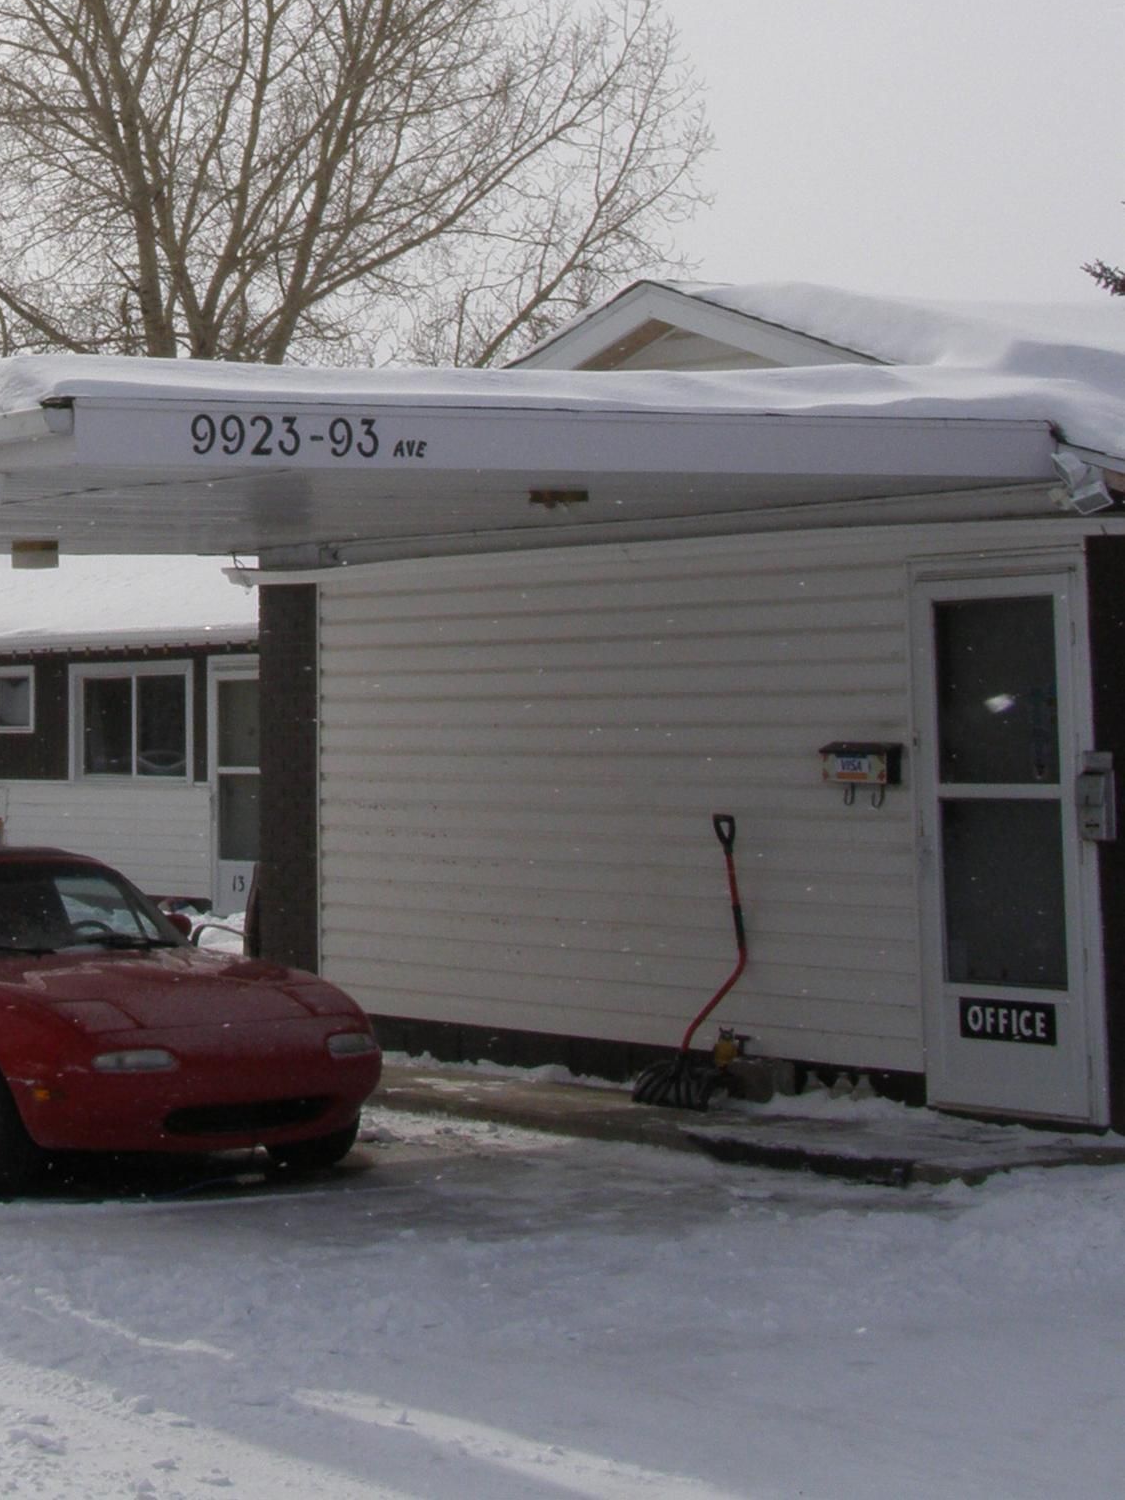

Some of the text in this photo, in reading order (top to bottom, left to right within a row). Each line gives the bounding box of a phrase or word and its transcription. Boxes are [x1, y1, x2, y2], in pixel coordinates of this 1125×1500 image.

[190, 413, 427, 458] 9923-93 AVE
[840, 758, 863, 771] VISA
[232, 874, 245, 893] 13
[967, 1004, 1047, 1039] OFFICE
